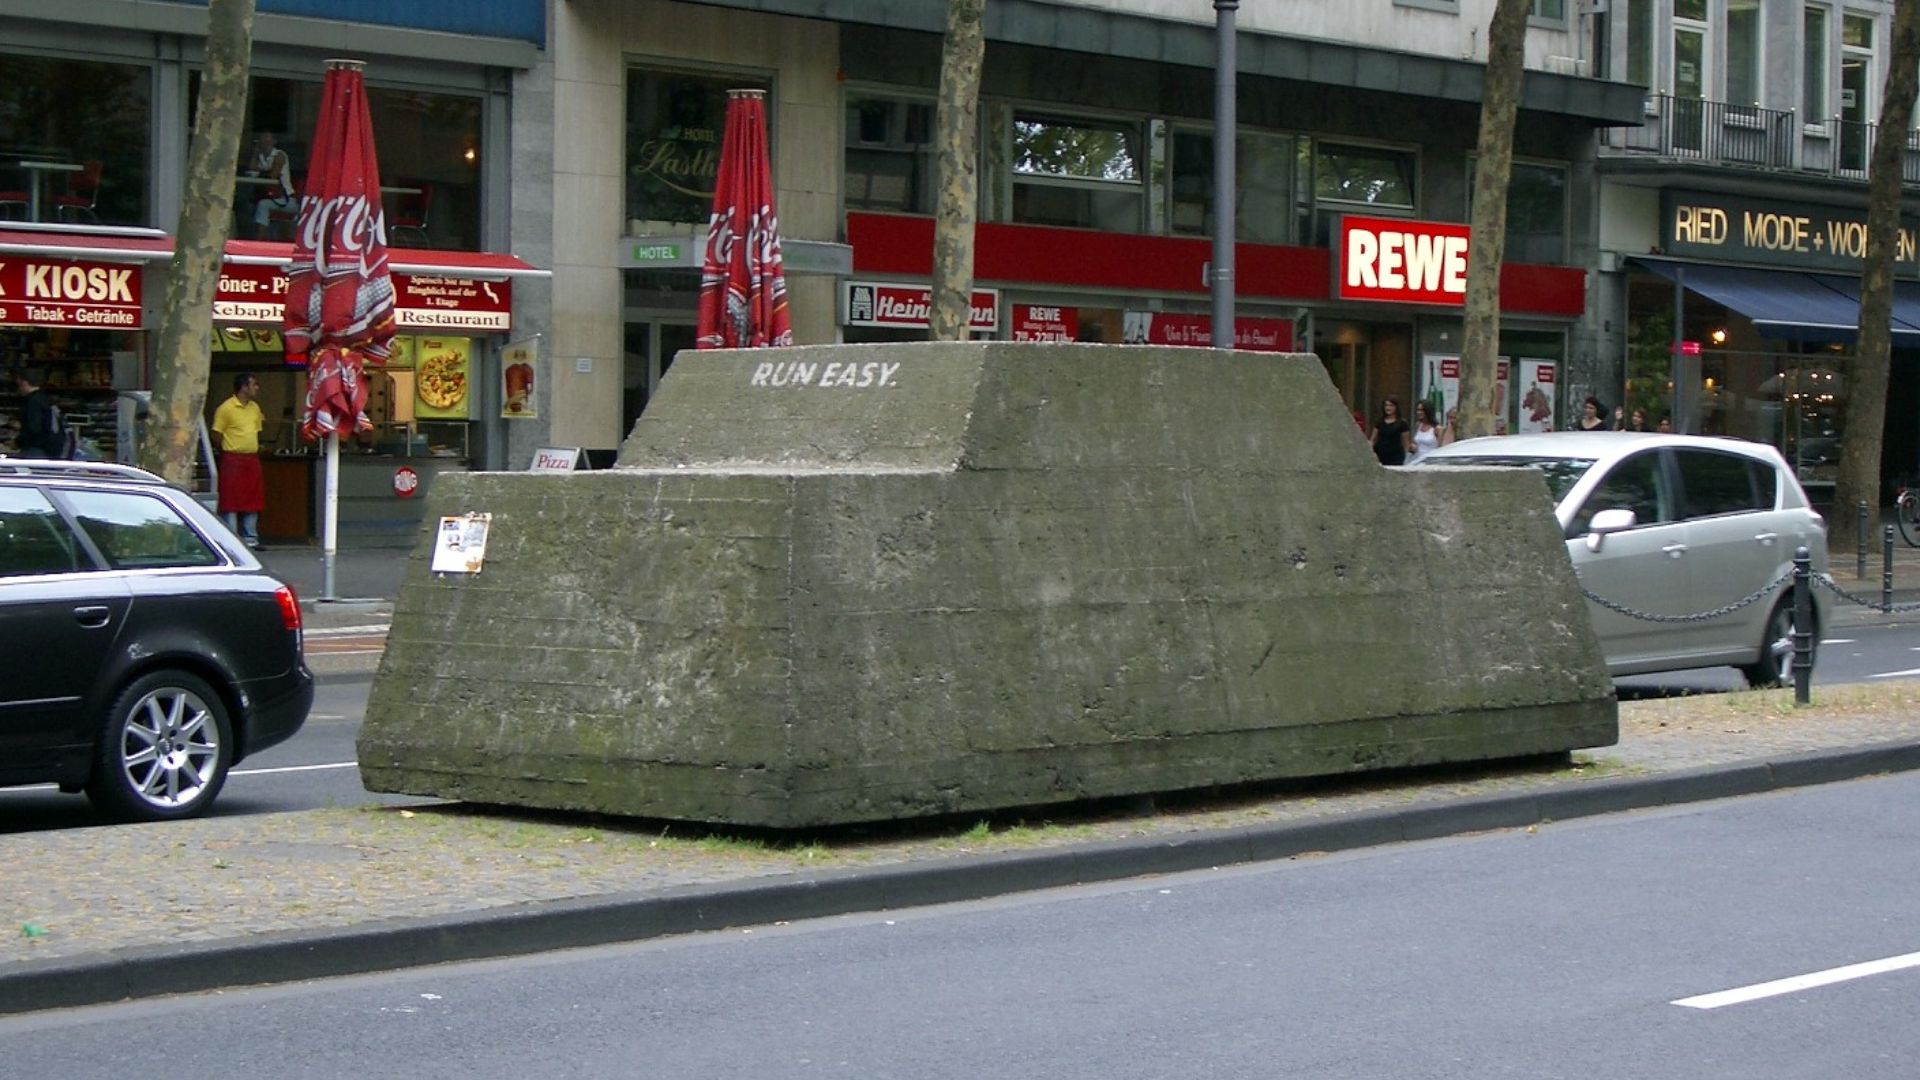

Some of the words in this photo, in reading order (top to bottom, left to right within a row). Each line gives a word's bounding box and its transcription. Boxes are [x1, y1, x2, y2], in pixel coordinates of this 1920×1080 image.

[1675, 205, 1728, 245] RIED
[1744, 211, 1810, 252] MODE
[1827, 220, 1915, 262] WON
[640, 246, 675, 259] HOTEL
[1347, 229, 1467, 293] REWE
[26, 264, 133, 302] KIOSK
[219, 274, 258, 293] öner
[271, 276, 290, 294] Pi
[25, 306, 65, 321] Tabak
[75, 308, 134, 324] Getränke
[401, 311, 500, 326] Restaurant
[877, 296, 994, 322] Heinnn
[1029, 307, 1061, 321] REWE
[751, 361, 818, 387] RUN
[819, 361, 900, 387] EASY.
[537, 454, 570, 469] Pizza
